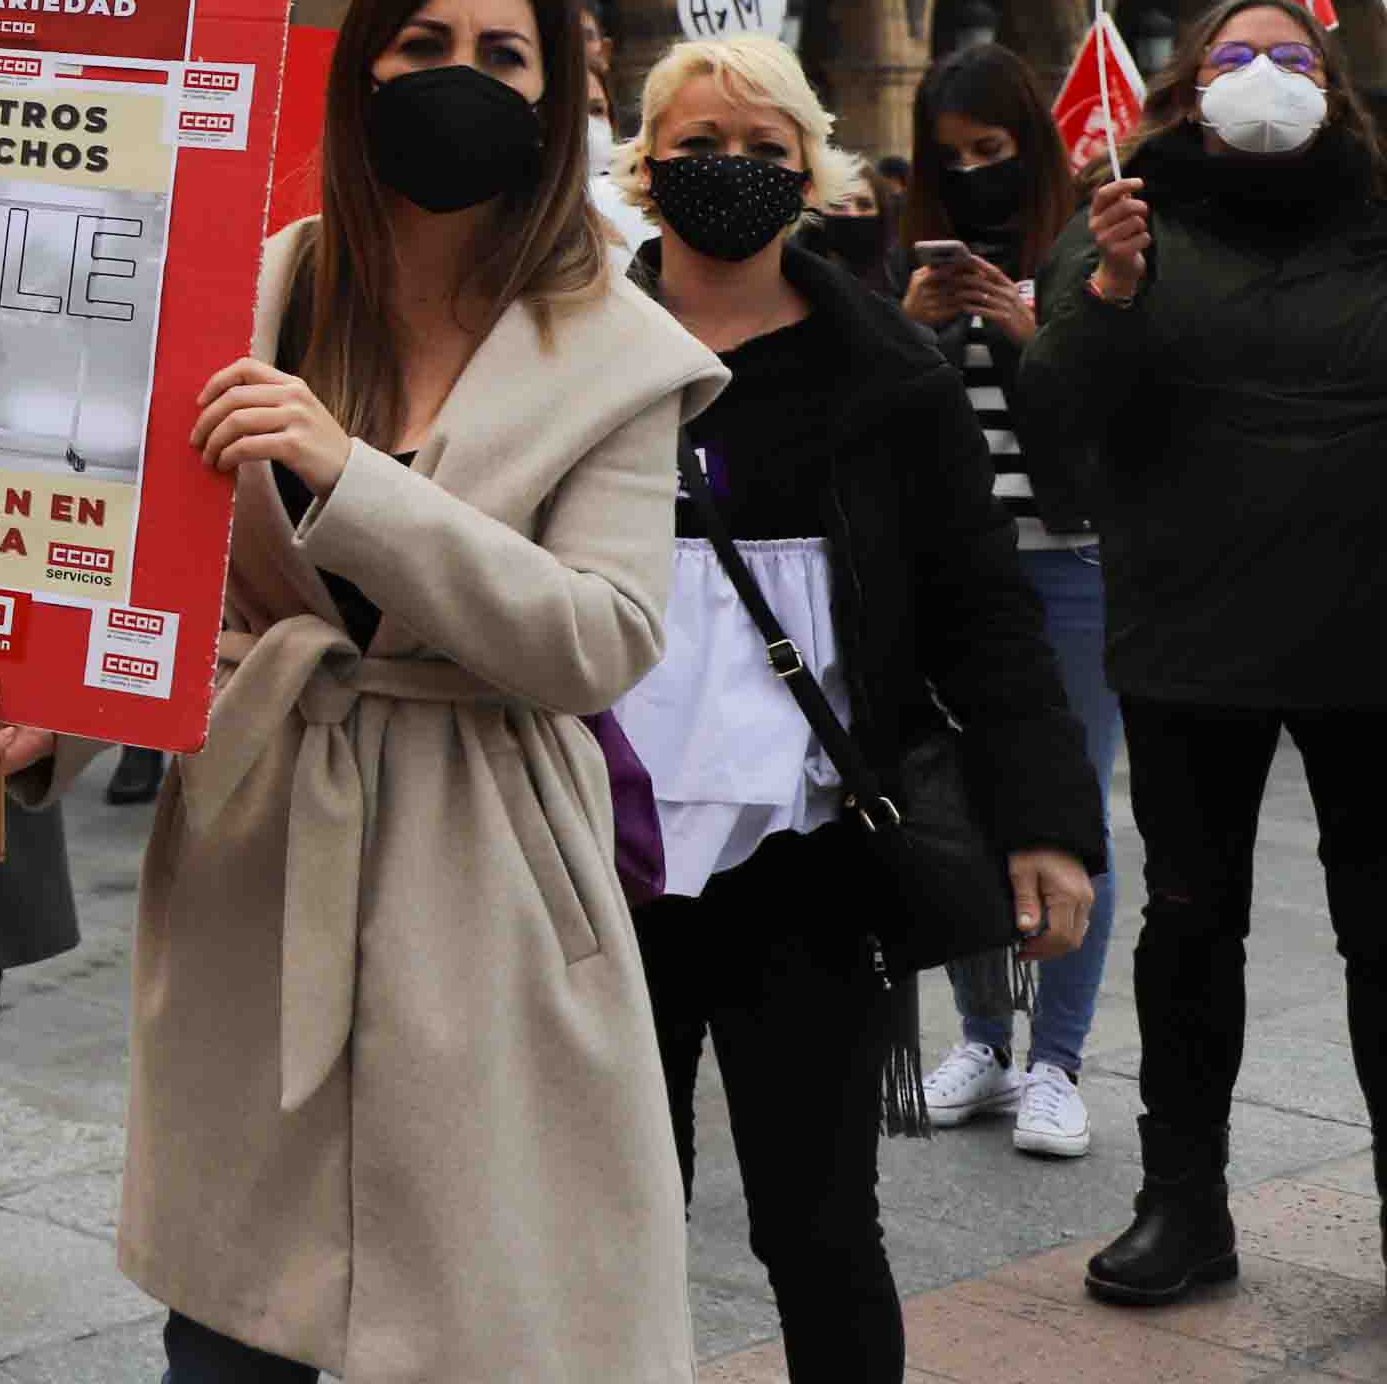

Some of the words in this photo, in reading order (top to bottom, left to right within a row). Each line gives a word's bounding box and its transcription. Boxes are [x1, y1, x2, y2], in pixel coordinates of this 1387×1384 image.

[182, 114, 231, 130] CCOO
[50, 493, 106, 527] EN
[51, 546, 110, 569] CCOO
[46, 566, 113, 586] servicios
[111, 611, 163, 631] CCOO
[104, 656, 157, 676] CCOO
